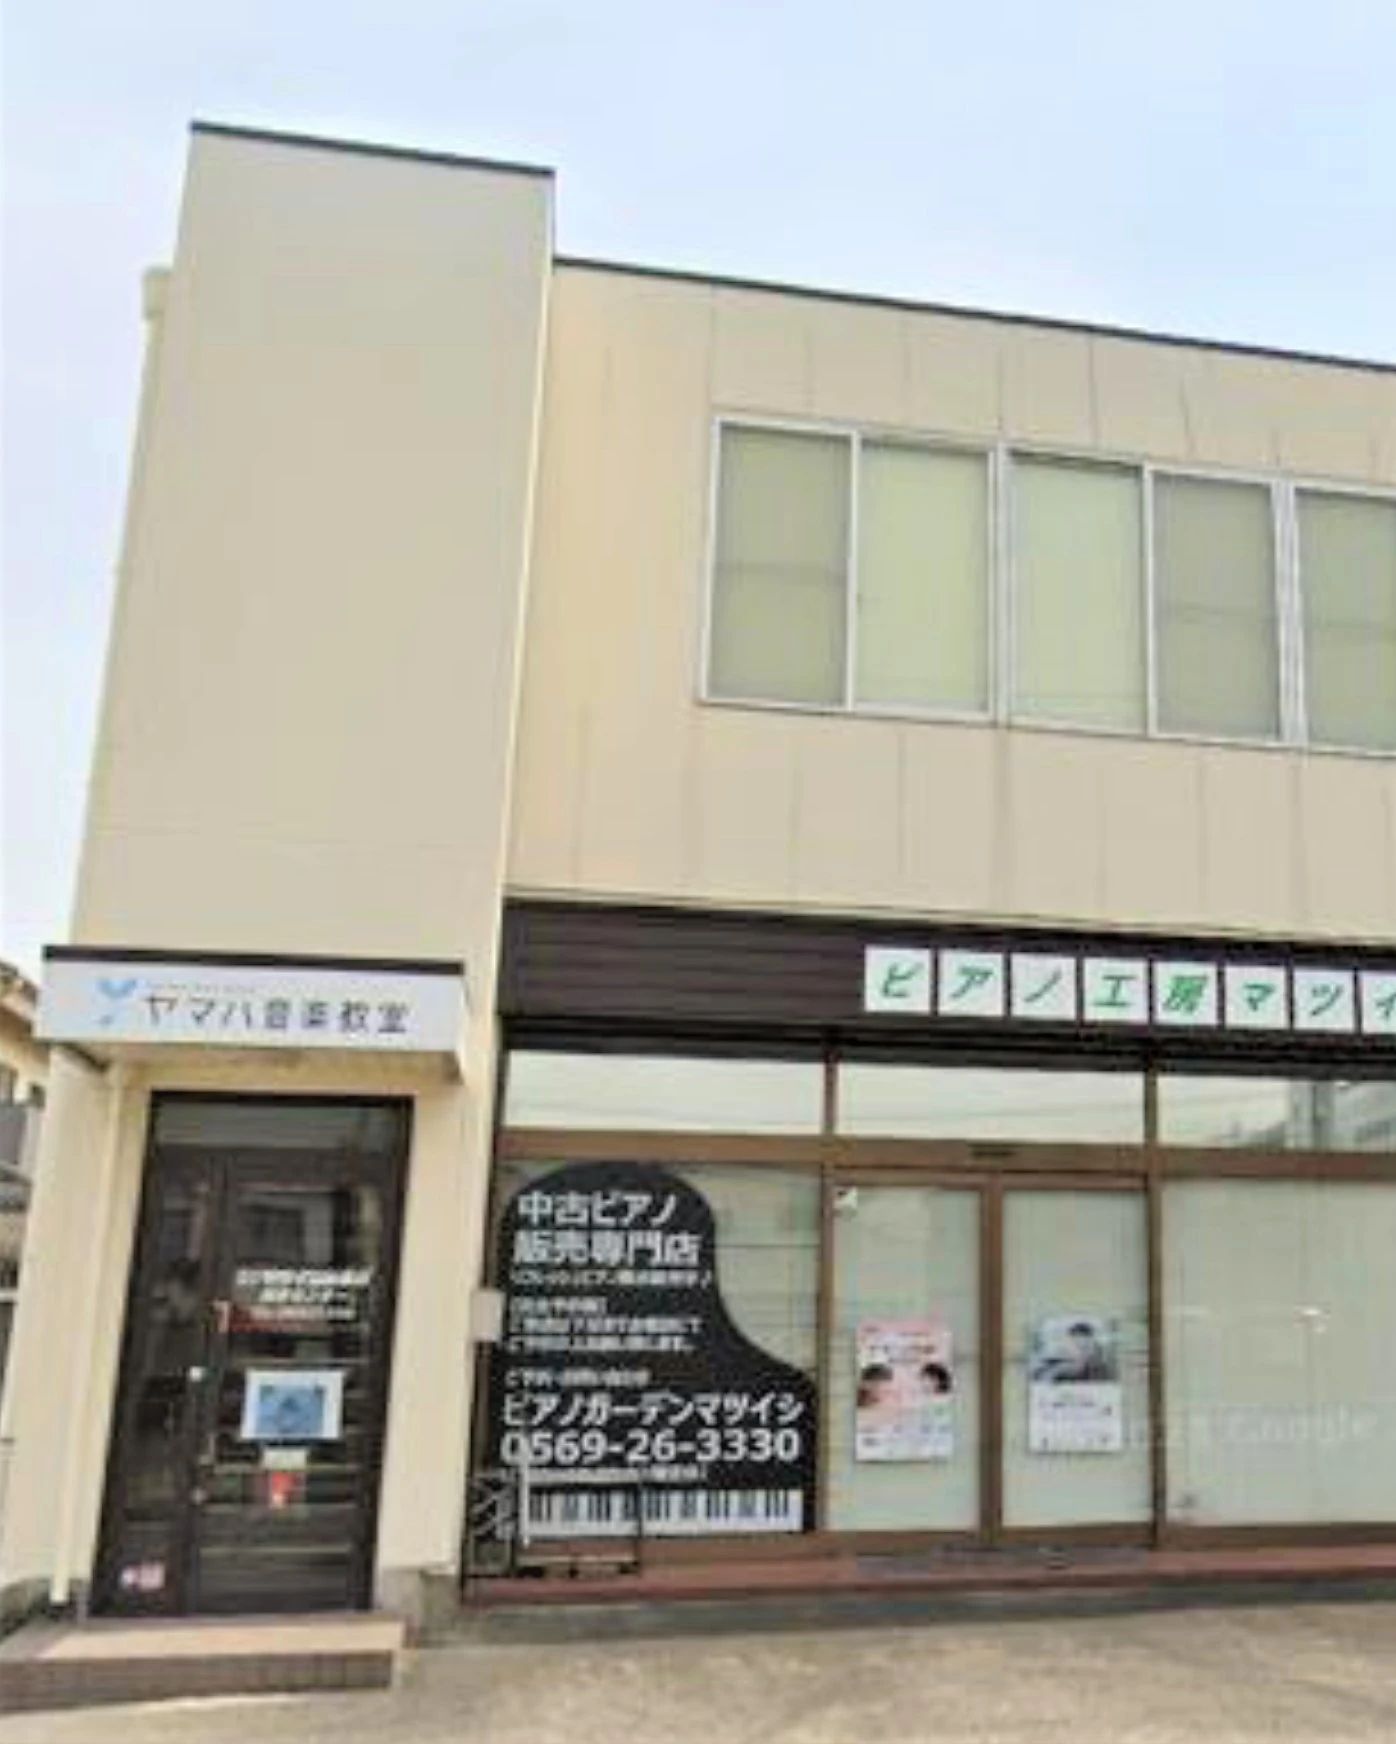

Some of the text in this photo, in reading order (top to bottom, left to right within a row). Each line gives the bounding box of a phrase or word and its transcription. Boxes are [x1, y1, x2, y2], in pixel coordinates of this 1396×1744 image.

[144, 997, 410, 1034] ヤマハ音楽教室
[517, 1190, 677, 1227] 中古ピアノ
[512, 1229, 700, 1265] 販売専門店
[503, 1391, 803, 1426] ピアノガーデンマツイシ
[500, 1428, 801, 1464] 0569-26-3330
